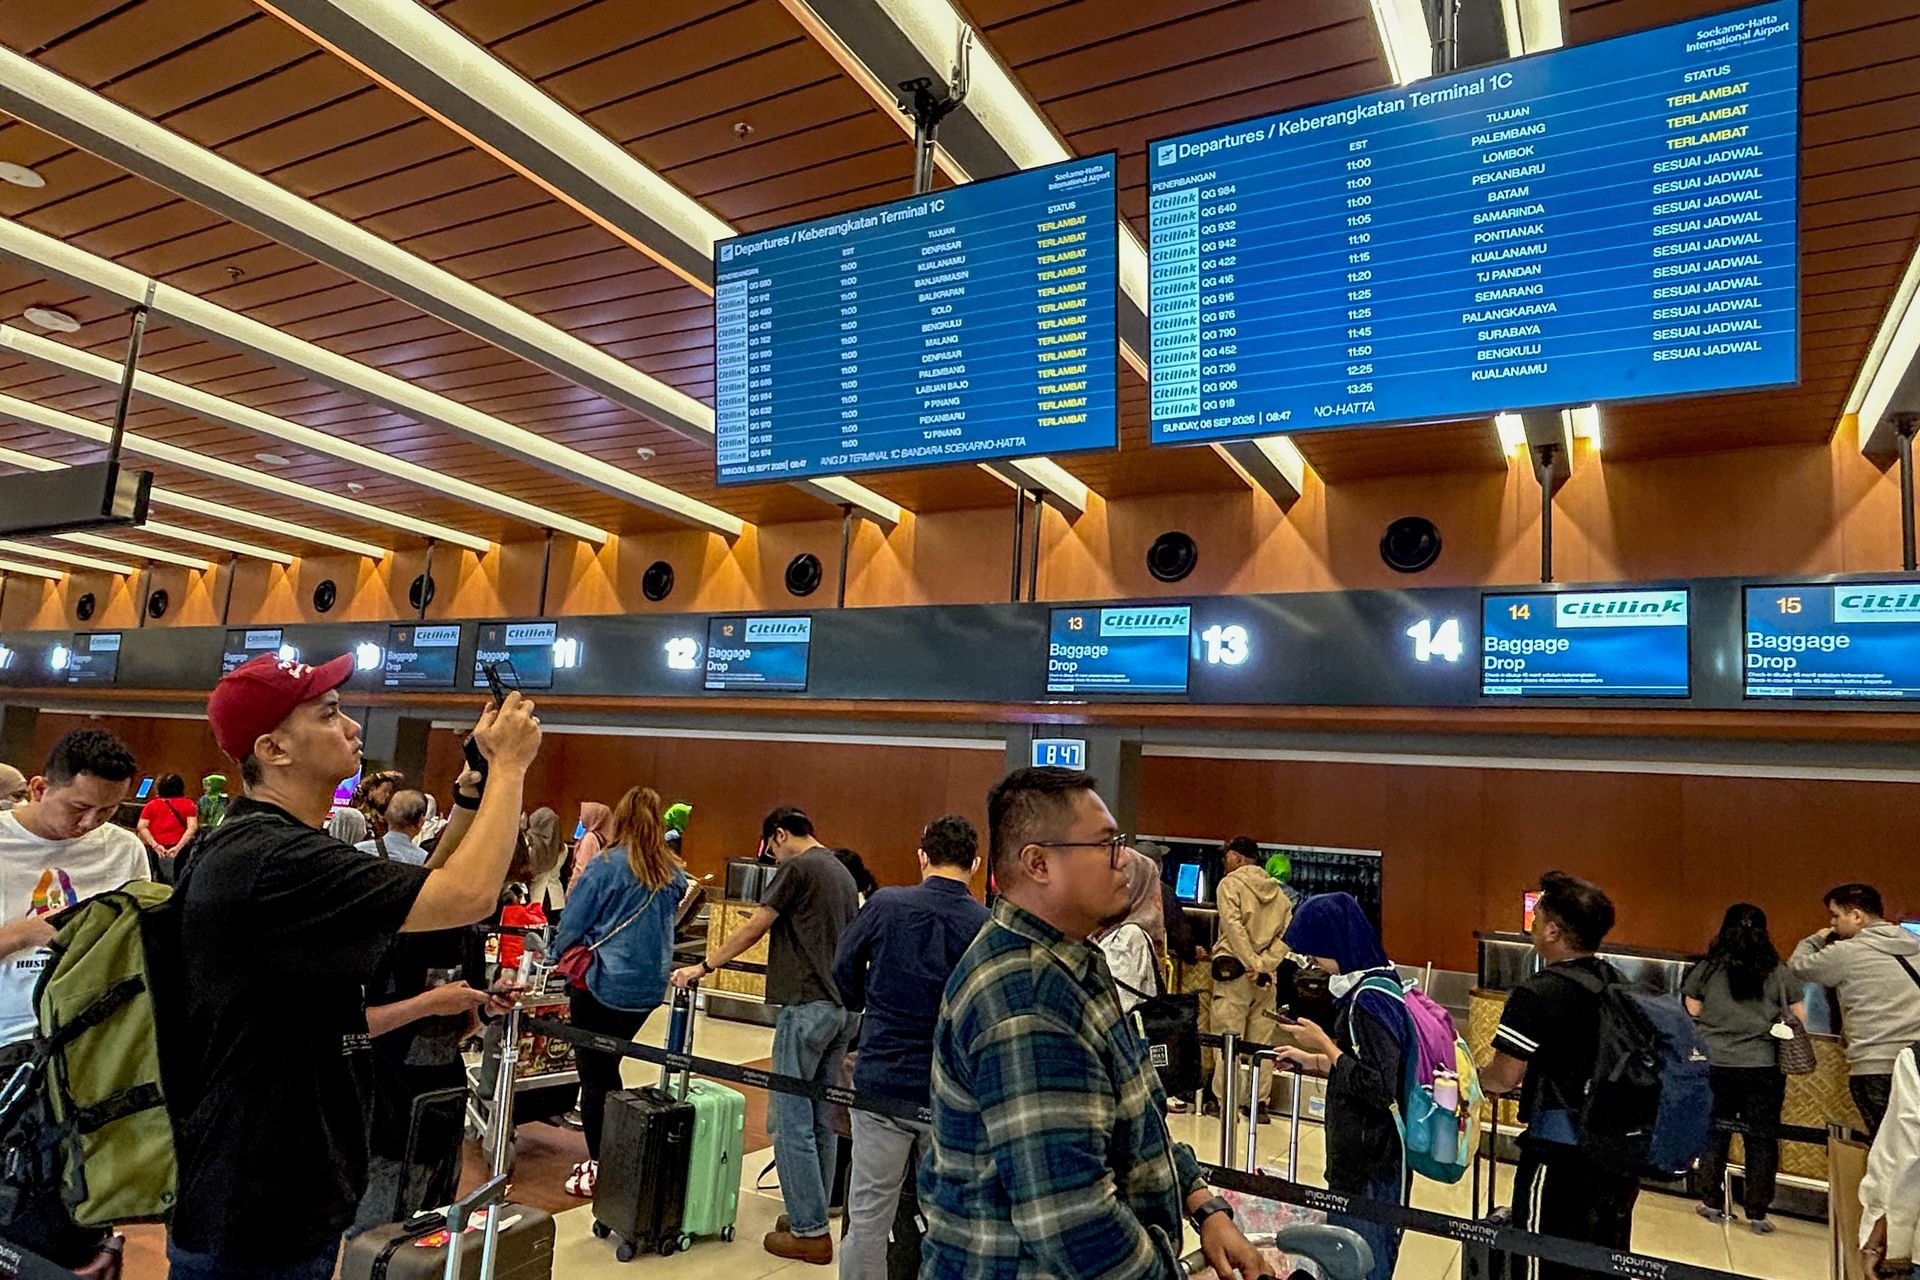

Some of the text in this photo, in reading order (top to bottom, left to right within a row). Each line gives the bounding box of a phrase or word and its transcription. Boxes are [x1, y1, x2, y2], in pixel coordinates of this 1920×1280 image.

[1697, 15, 1777, 39] Soekarno-Hatta
[1686, 29, 1749, 52] International
[1753, 22, 1789, 37] Airport
[1684, 64, 1731, 82] STATUS
[1666, 82, 1749, 107] TERLAMBAT
[1179, 130, 1264, 158] Departures
[1279, 99, 1404, 136] Keberangkatan
[1408, 77, 1484, 107] Terminal
[1489, 72, 1512, 90] 1C
[1486, 106, 1529, 123] TUJUAN
[1666, 103, 1748, 128] TERLAMBAT
[1471, 123, 1545, 146] PALEMBANG
[1666, 125, 1749, 149] TERLAMBAT
[1349, 139, 1368, 151] EST
[1482, 145, 1534, 163] LOMBOK
[1653, 145, 1763, 173] SESUAI JADWAL
[1152, 171, 1216, 191] PENERBANGAN
[1472, 163, 1545, 185] PEKANBARU
[1653, 167, 1762, 194] SESUAI JADWAL
[1152, 193, 1196, 209] Citilink
[1487, 186, 1528, 202] BATAM
[1653, 189, 1762, 215] SESUAI JADWAL
[1047, 201, 1076, 213] STATUS
[1201, 206, 1216, 217] QG
[1473, 203, 1544, 224] SAMARINDA
[1037, 215, 1086, 232] TERLAMBAT
[1152, 210, 1196, 227] Citilink
[1653, 211, 1762, 236] SESUAI JADWAL
[734, 236, 789, 256] Departures
[797, 216, 877, 242] Keberangkatan
[879, 202, 927, 224] Terminal
[929, 199, 944, 213] 1C
[1152, 228, 1196, 244] Citilink
[1201, 224, 1216, 234] QG
[1474, 223, 1543, 243] PONTIANAK
[1037, 231, 1086, 248] TERLAMBAT
[1201, 241, 1216, 252] QG
[1653, 232, 1762, 257] SESUAI JADWAL
[1037, 248, 1087, 264] TERLAMBAT
[1152, 245, 1196, 261] Citilink
[1471, 243, 1547, 263] KUALANAMU
[1037, 265, 1087, 280] TERLAMBAT
[1152, 263, 1196, 278] Citilink
[1201, 259, 1216, 269] QG
[1653, 254, 1762, 278] SESUAI JADWAL
[1476, 264, 1541, 282] TJ PANDAN
[1037, 281, 1087, 297] TERLAMBAT
[1153, 280, 1196, 296] Citilink
[1475, 284, 1543, 302] SEMARANG
[1653, 275, 1762, 299] SESUAI JADWAL
[1037, 298, 1087, 313] TERLAMBAT
[1153, 298, 1196, 313] Citilink
[1462, 302, 1557, 323] PALANGKARAYA
[1652, 297, 1762, 319] SESUAI JADWAL
[1037, 314, 1087, 329] TERLAMBAT
[1153, 315, 1196, 330] Citilink
[1652, 318, 1761, 340] SESUAI JADWAL
[1037, 331, 1087, 346] TERLAMBAT
[1153, 333, 1196, 347] Citilink
[1478, 324, 1541, 341] SURABAYA
[1037, 347, 1087, 362] TERLAMBAT
[1153, 350, 1197, 364] Citilink
[1477, 343, 1541, 360] BENGKULU
[1653, 340, 1761, 361] SESUAI JADWAL
[1037, 364, 1087, 378] TERLAMBAT
[1153, 367, 1197, 382] Citilink
[1471, 363, 1547, 380] KUALANAMU
[1037, 380, 1087, 394] TERLAMBAT
[1153, 385, 1197, 399] Citilink
[1037, 397, 1087, 410] TERLAMBAT
[1153, 403, 1197, 416] Citilink
[1037, 413, 1087, 426] TERLAMBAT
[1213, 417, 1231, 427] SEP
[1508, 604, 1531, 620] 14
[1562, 599, 1685, 615] Citilink
[1776, 597, 1802, 614] 15
[748, 623, 809, 634] Citilink
[1067, 616, 1083, 630] 13
[1104, 614, 1188, 626] Citilink
[416, 629, 459, 641] Citilink
[507, 627, 554, 639] Citilink
[722, 625, 734, 637] 12
[1201, 624, 1250, 665] 13
[1406, 619, 1463, 662] 14
[1484, 636, 1570, 655] Baggage
[1747, 632, 1851, 652] Baggage
[553, 637, 578, 668] 11
[664, 637, 698, 670] 12
[708, 647, 751, 661] Baggage
[1049, 643, 1109, 659] Baggage
[706, 660, 729, 673] Drop
[1048, 659, 1078, 673] Drop
[1484, 656, 1526, 672] Drop
[1747, 653, 1797, 672] Drop
[1304, 1189, 1350, 1207] injourney
[1448, 1220, 1498, 1238] injourney
[1611, 1253, 1669, 1274] injourney
